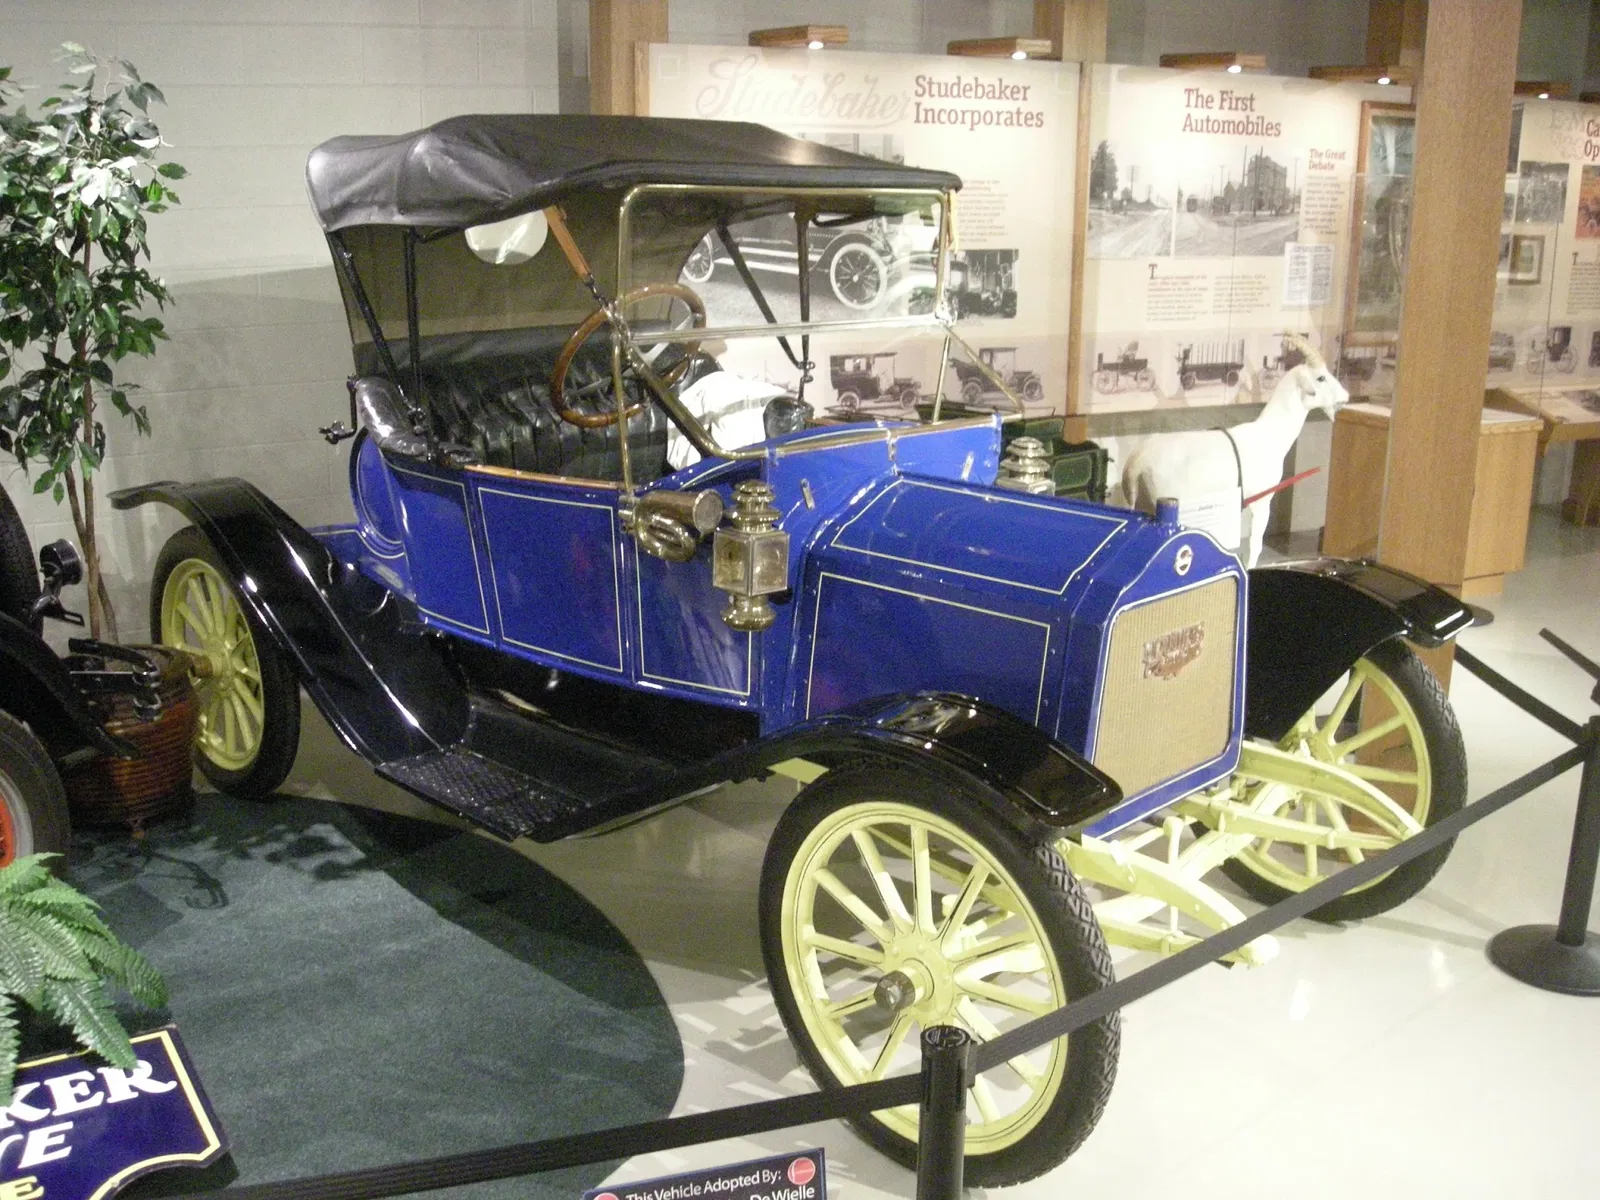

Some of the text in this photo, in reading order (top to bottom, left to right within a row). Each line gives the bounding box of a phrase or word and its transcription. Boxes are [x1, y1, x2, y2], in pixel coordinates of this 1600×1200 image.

[914, 74, 1031, 101] Studebaker
[1184, 87, 1256, 112] The First
[914, 101, 1045, 132] Incorporates
[1182, 112, 1282, 137] Automobiles
[654, 1182, 701, 1200] Vehicle
[704, 1170, 760, 1194] Adopted
[762, 1169, 782, 1185] By:
[772, 1185, 816, 1200] Wielle
